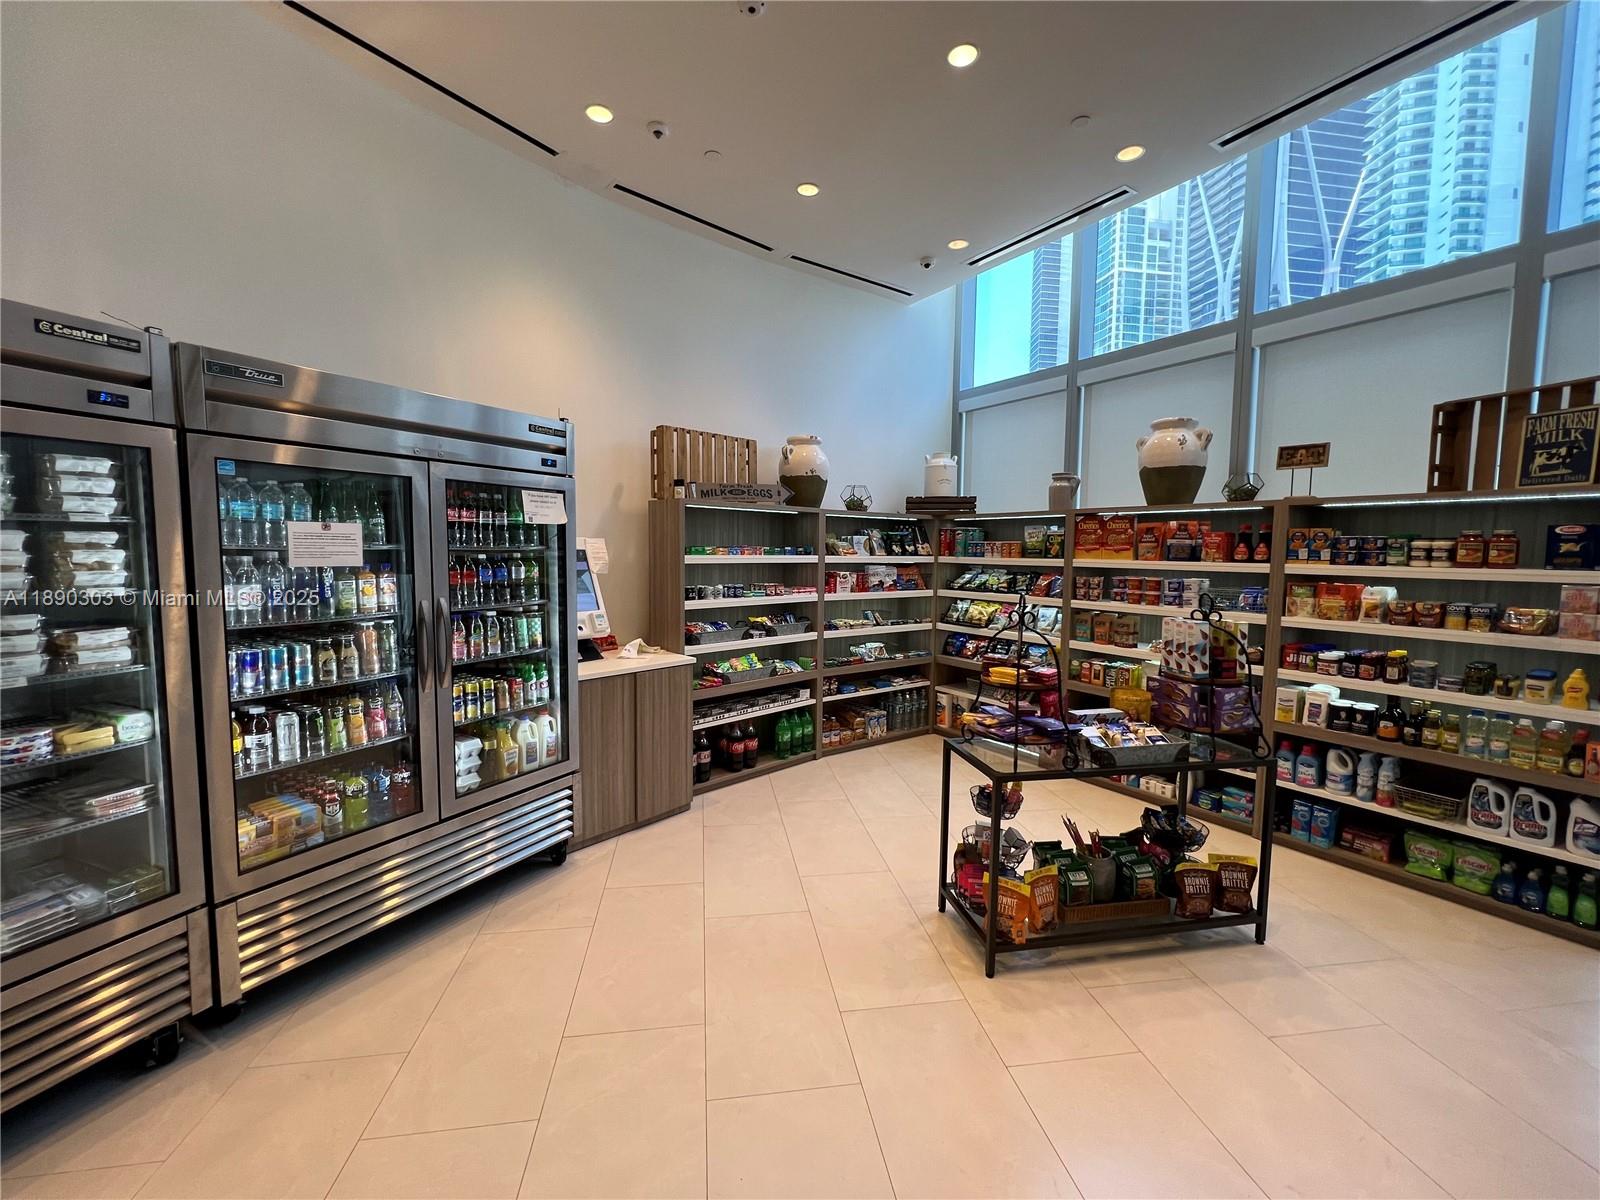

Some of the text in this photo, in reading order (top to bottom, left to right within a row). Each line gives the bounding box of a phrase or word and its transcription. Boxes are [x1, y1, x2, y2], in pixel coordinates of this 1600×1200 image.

[53, 324, 108, 342] Central
[239, 367, 279, 382] True
[1526, 410, 1597, 438] FARM FRESH
[1534, 429, 1584, 446] MILK
[700, 488, 773, 499] MILK EGGS
[1184, 876, 1209, 886] BROWNIE
[1220, 870, 1249, 880] BROWNIE
[1185, 885, 1210, 894] BRITTLE
[1222, 879, 1249, 889] BRITTLE
[998, 894, 1018, 907] OWNIE
[998, 903, 1017, 916] ITTLE
